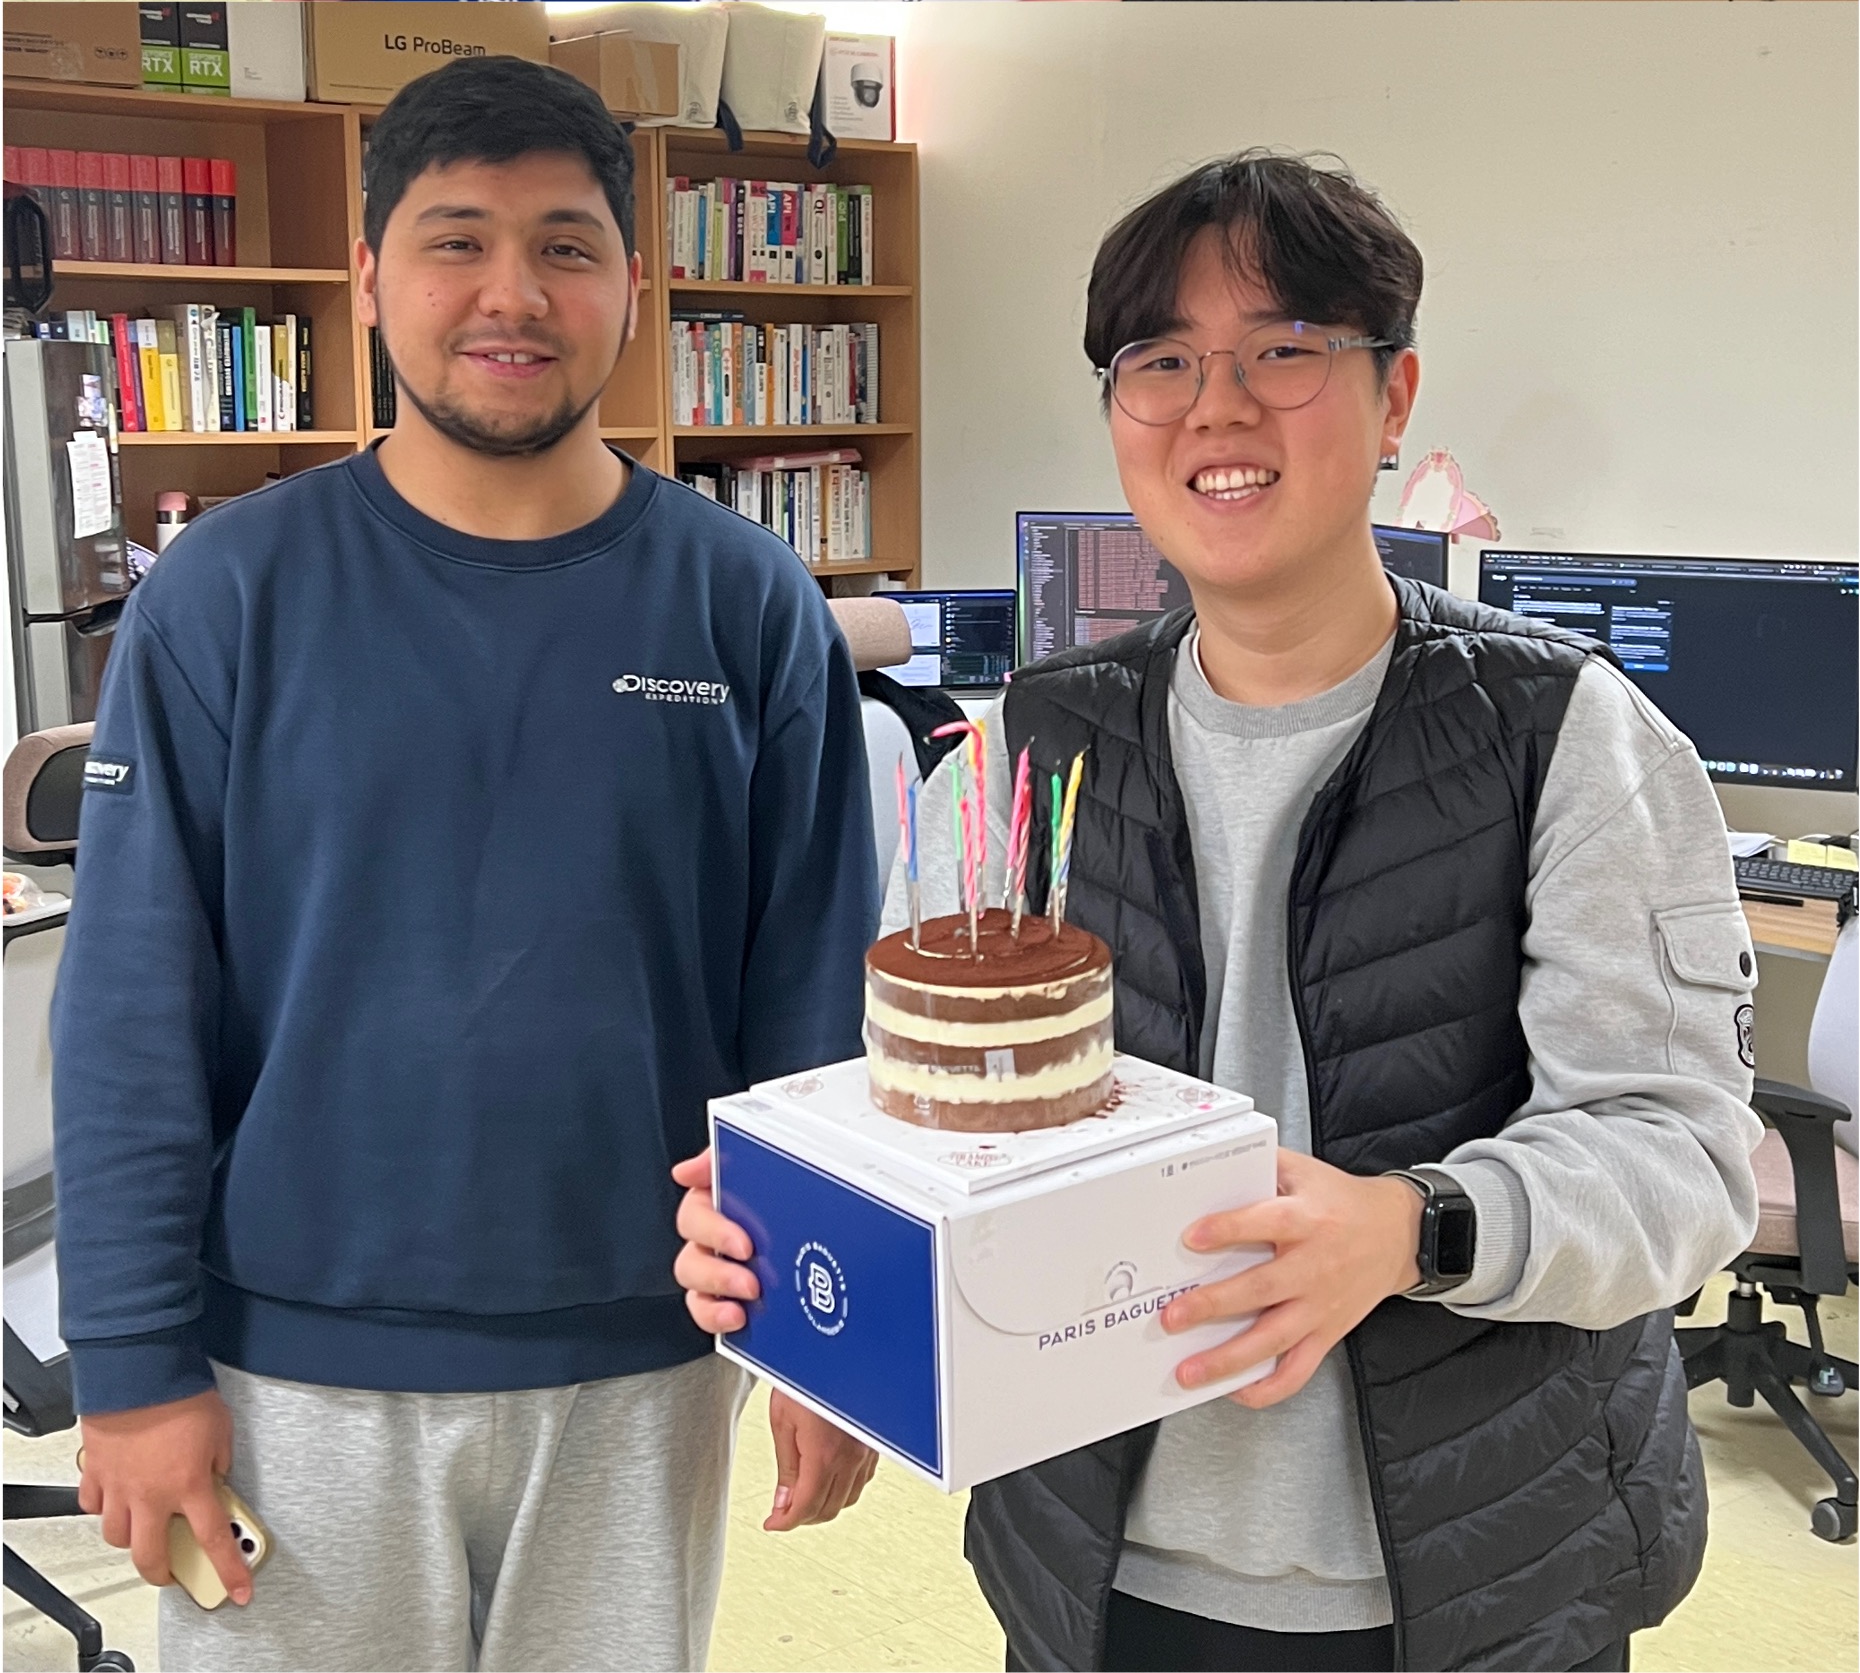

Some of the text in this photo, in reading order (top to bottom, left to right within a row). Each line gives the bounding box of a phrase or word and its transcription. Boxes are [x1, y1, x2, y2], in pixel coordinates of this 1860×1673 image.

[384, 34, 486, 57] LG ProBeam
[142, 57, 174, 74] RTX
[189, 59, 223, 78] RTX
[783, 192, 792, 214] API
[1038, 1319, 1096, 1351] PARIS
